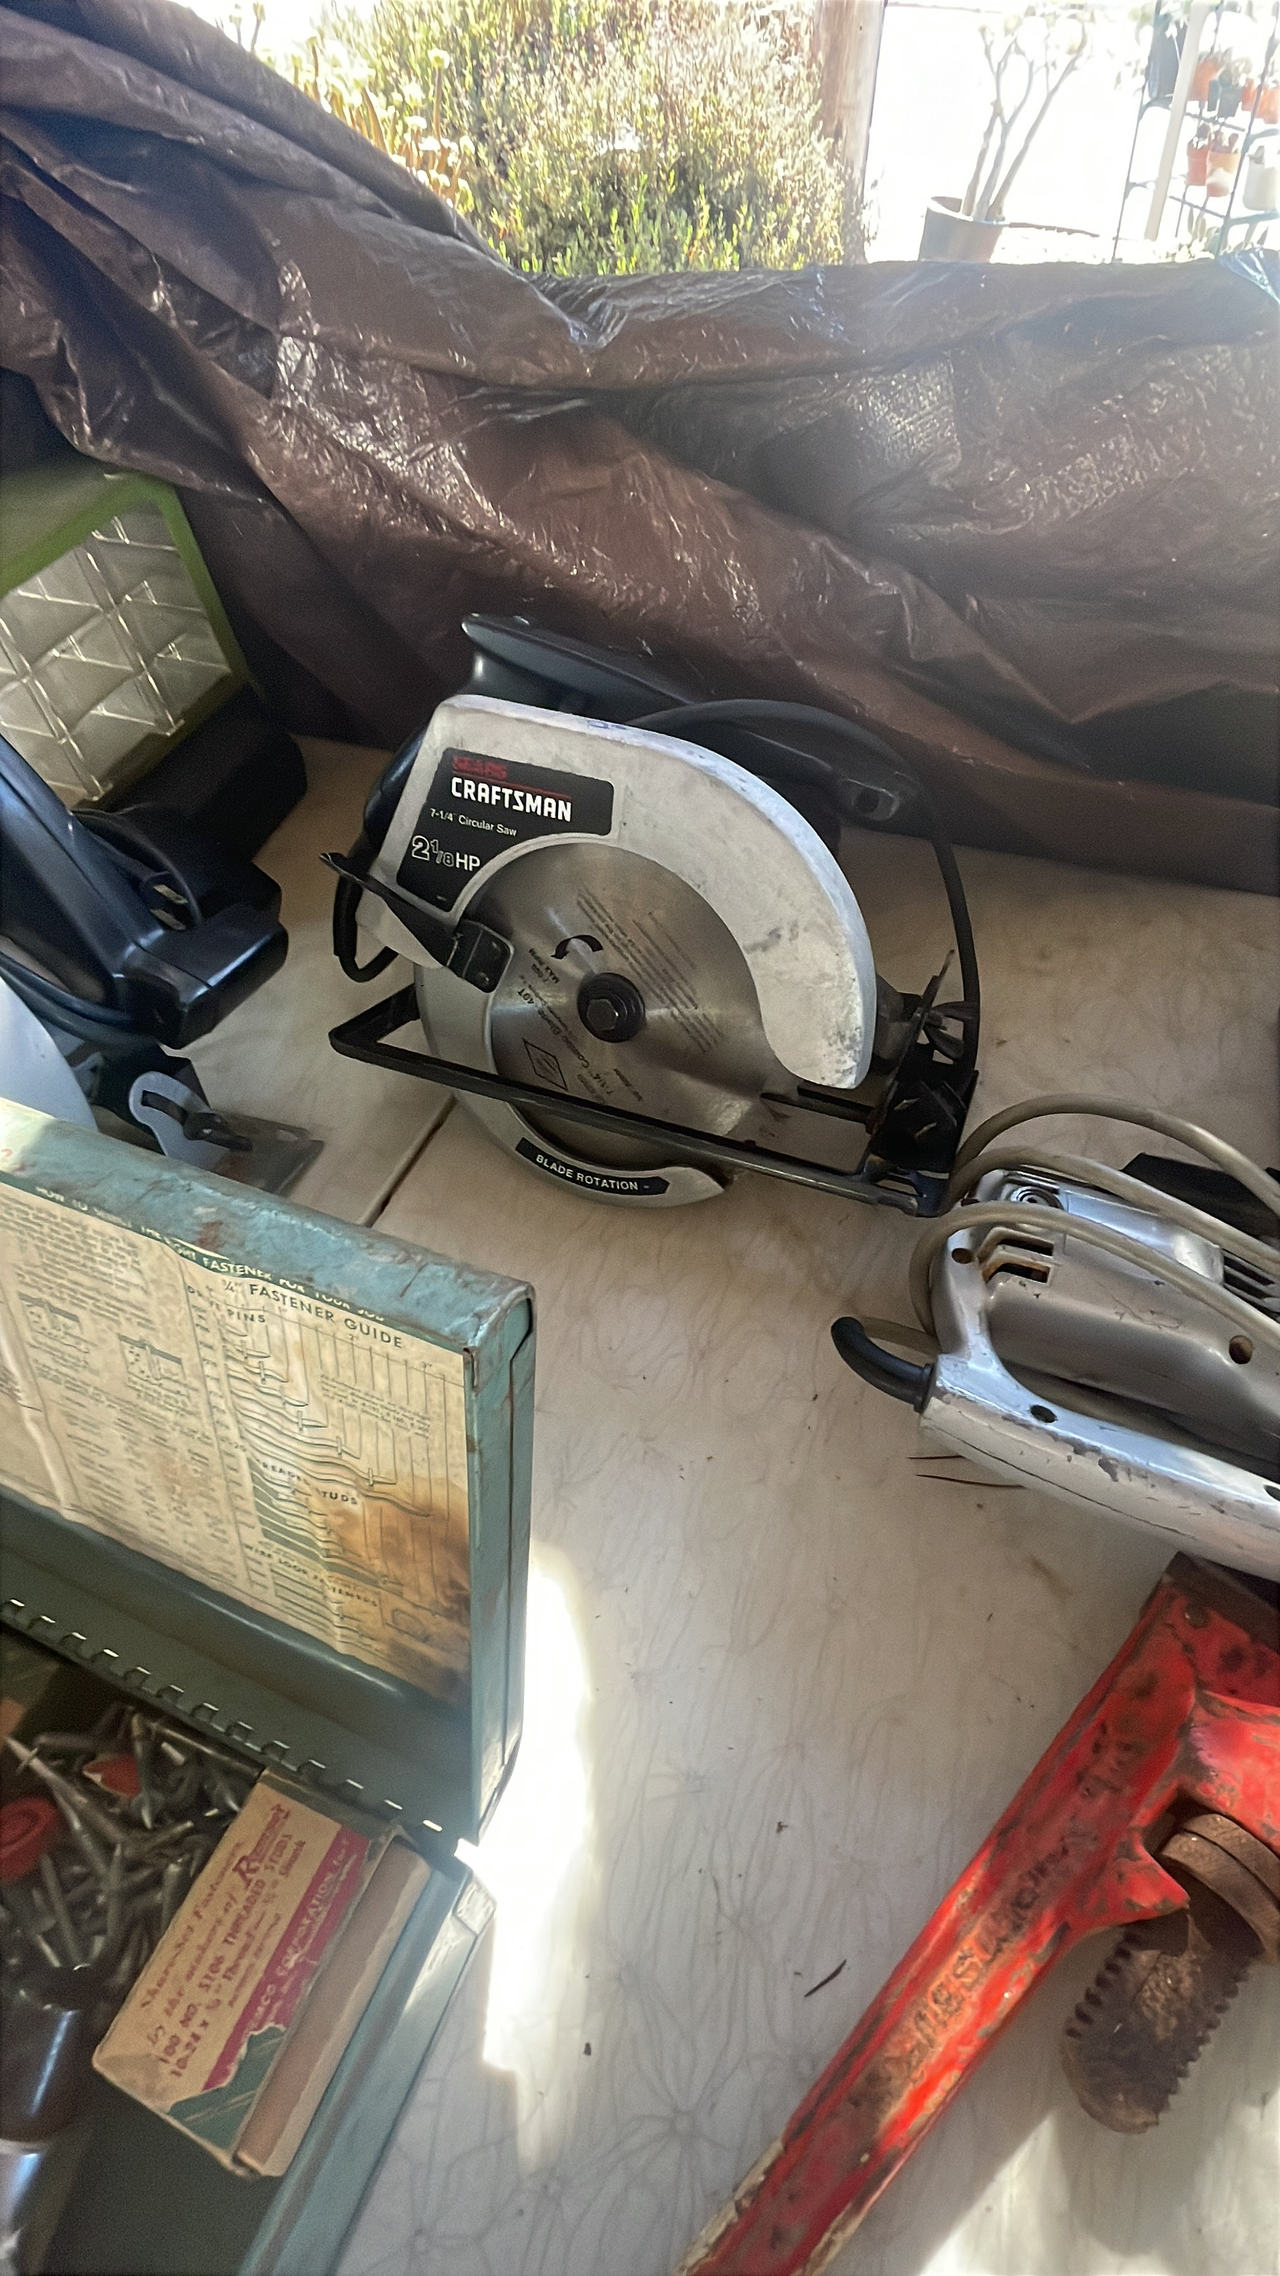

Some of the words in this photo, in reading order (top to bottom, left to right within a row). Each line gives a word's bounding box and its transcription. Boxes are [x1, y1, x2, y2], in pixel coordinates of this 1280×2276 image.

[451, 776, 572, 822] CRAFTSMAN
[458, 813, 495, 832] Circular
[496, 823, 517, 837] Saw
[535, 1154, 574, 1178] BLADE
[576, 1172, 639, 1191] ROTATION
[227, 1308, 266, 1324] PINS
[249, 1283, 334, 1322] FASTENER
[344, 1317, 403, 1349] GUIDE
